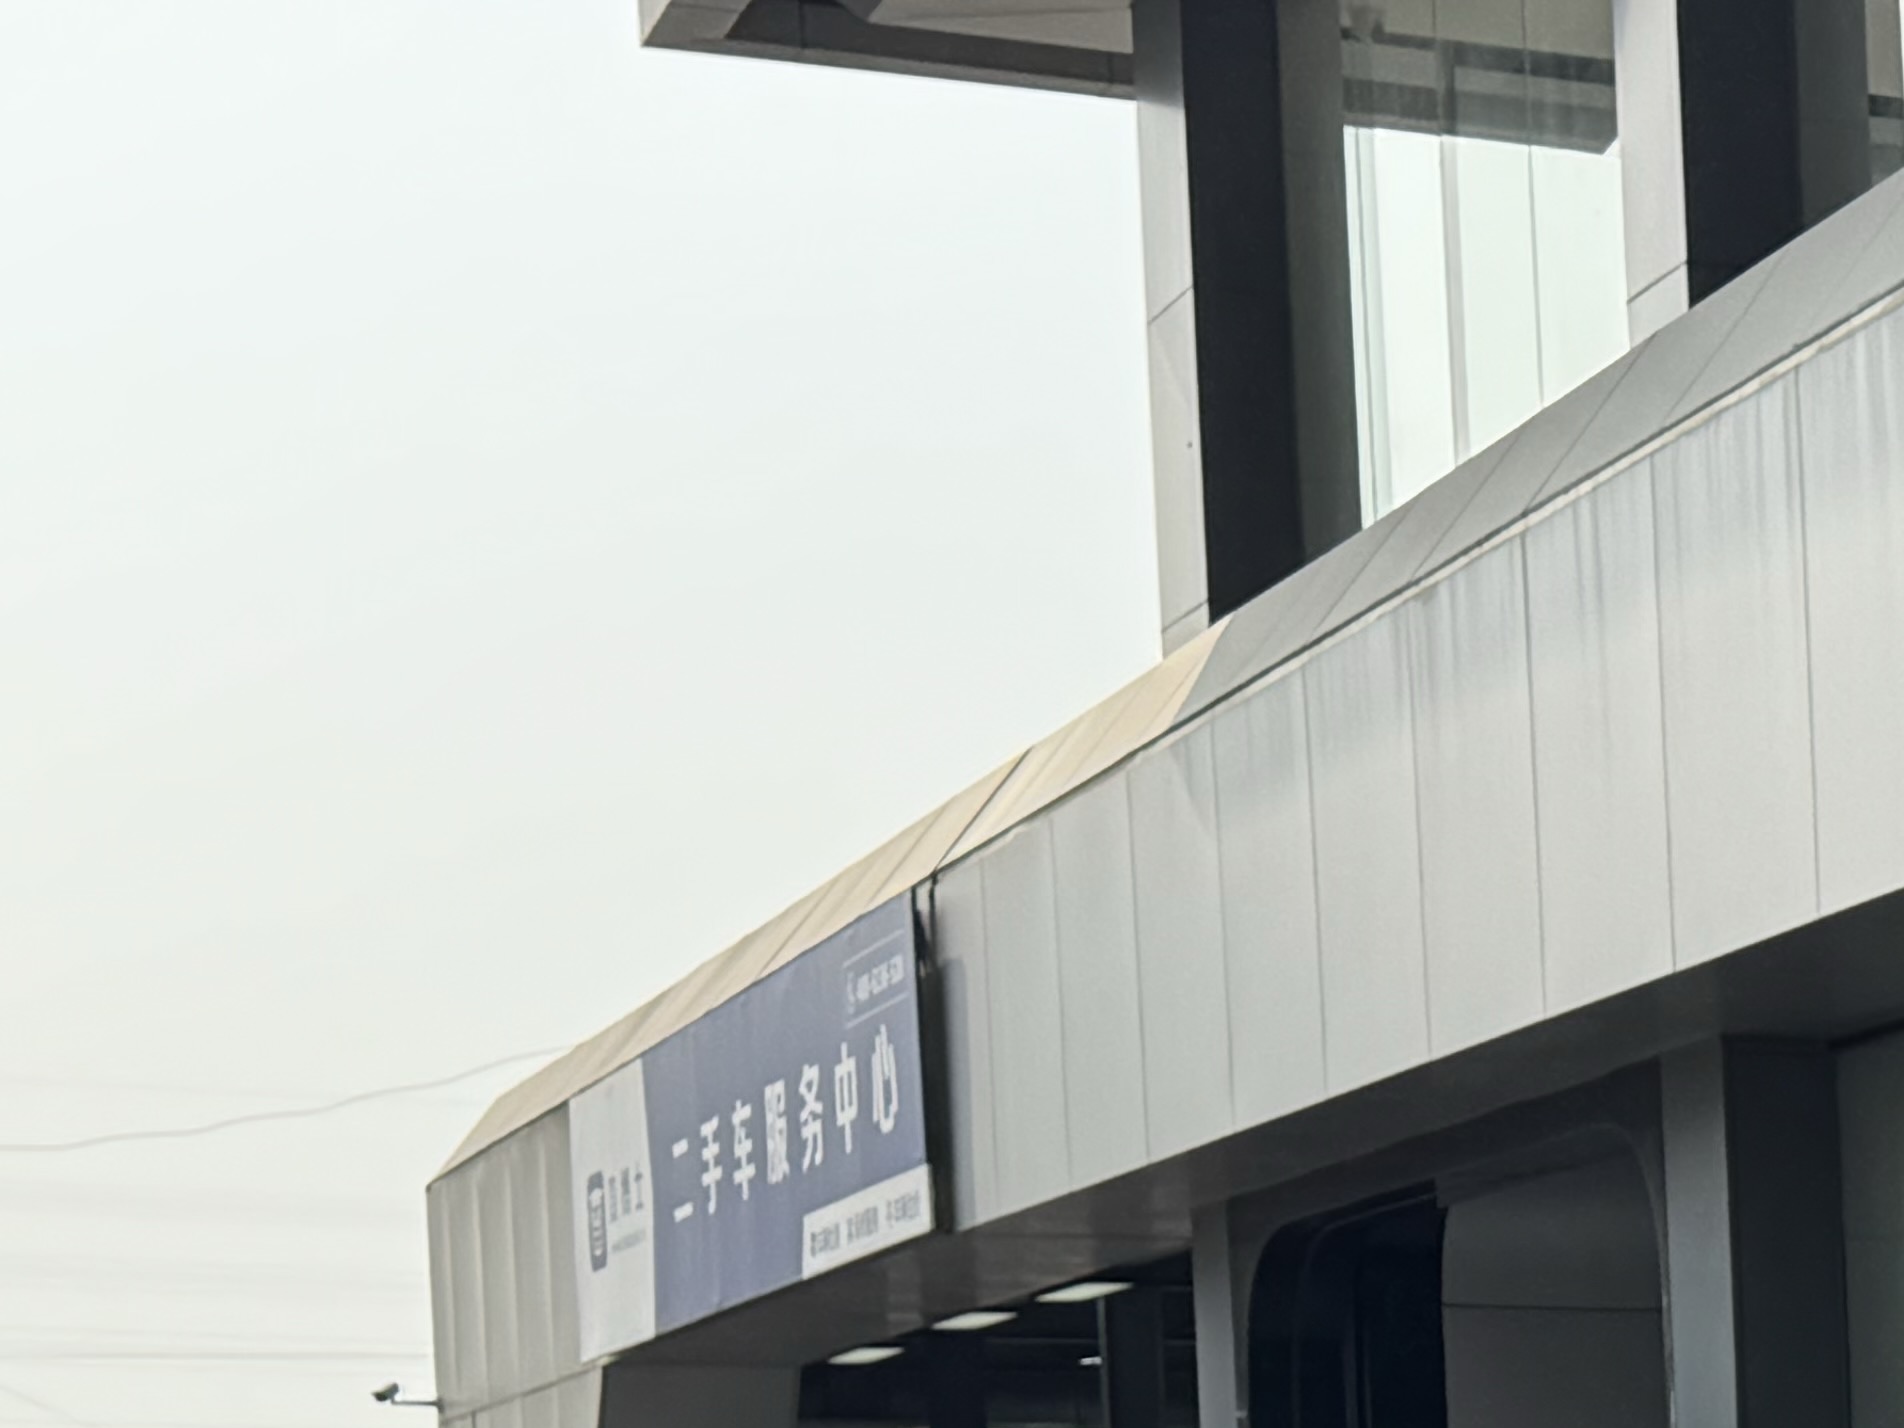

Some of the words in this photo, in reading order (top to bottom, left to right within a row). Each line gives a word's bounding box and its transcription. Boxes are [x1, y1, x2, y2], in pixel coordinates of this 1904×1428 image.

[672, 1024, 899, 1222] 二手车服务中心
